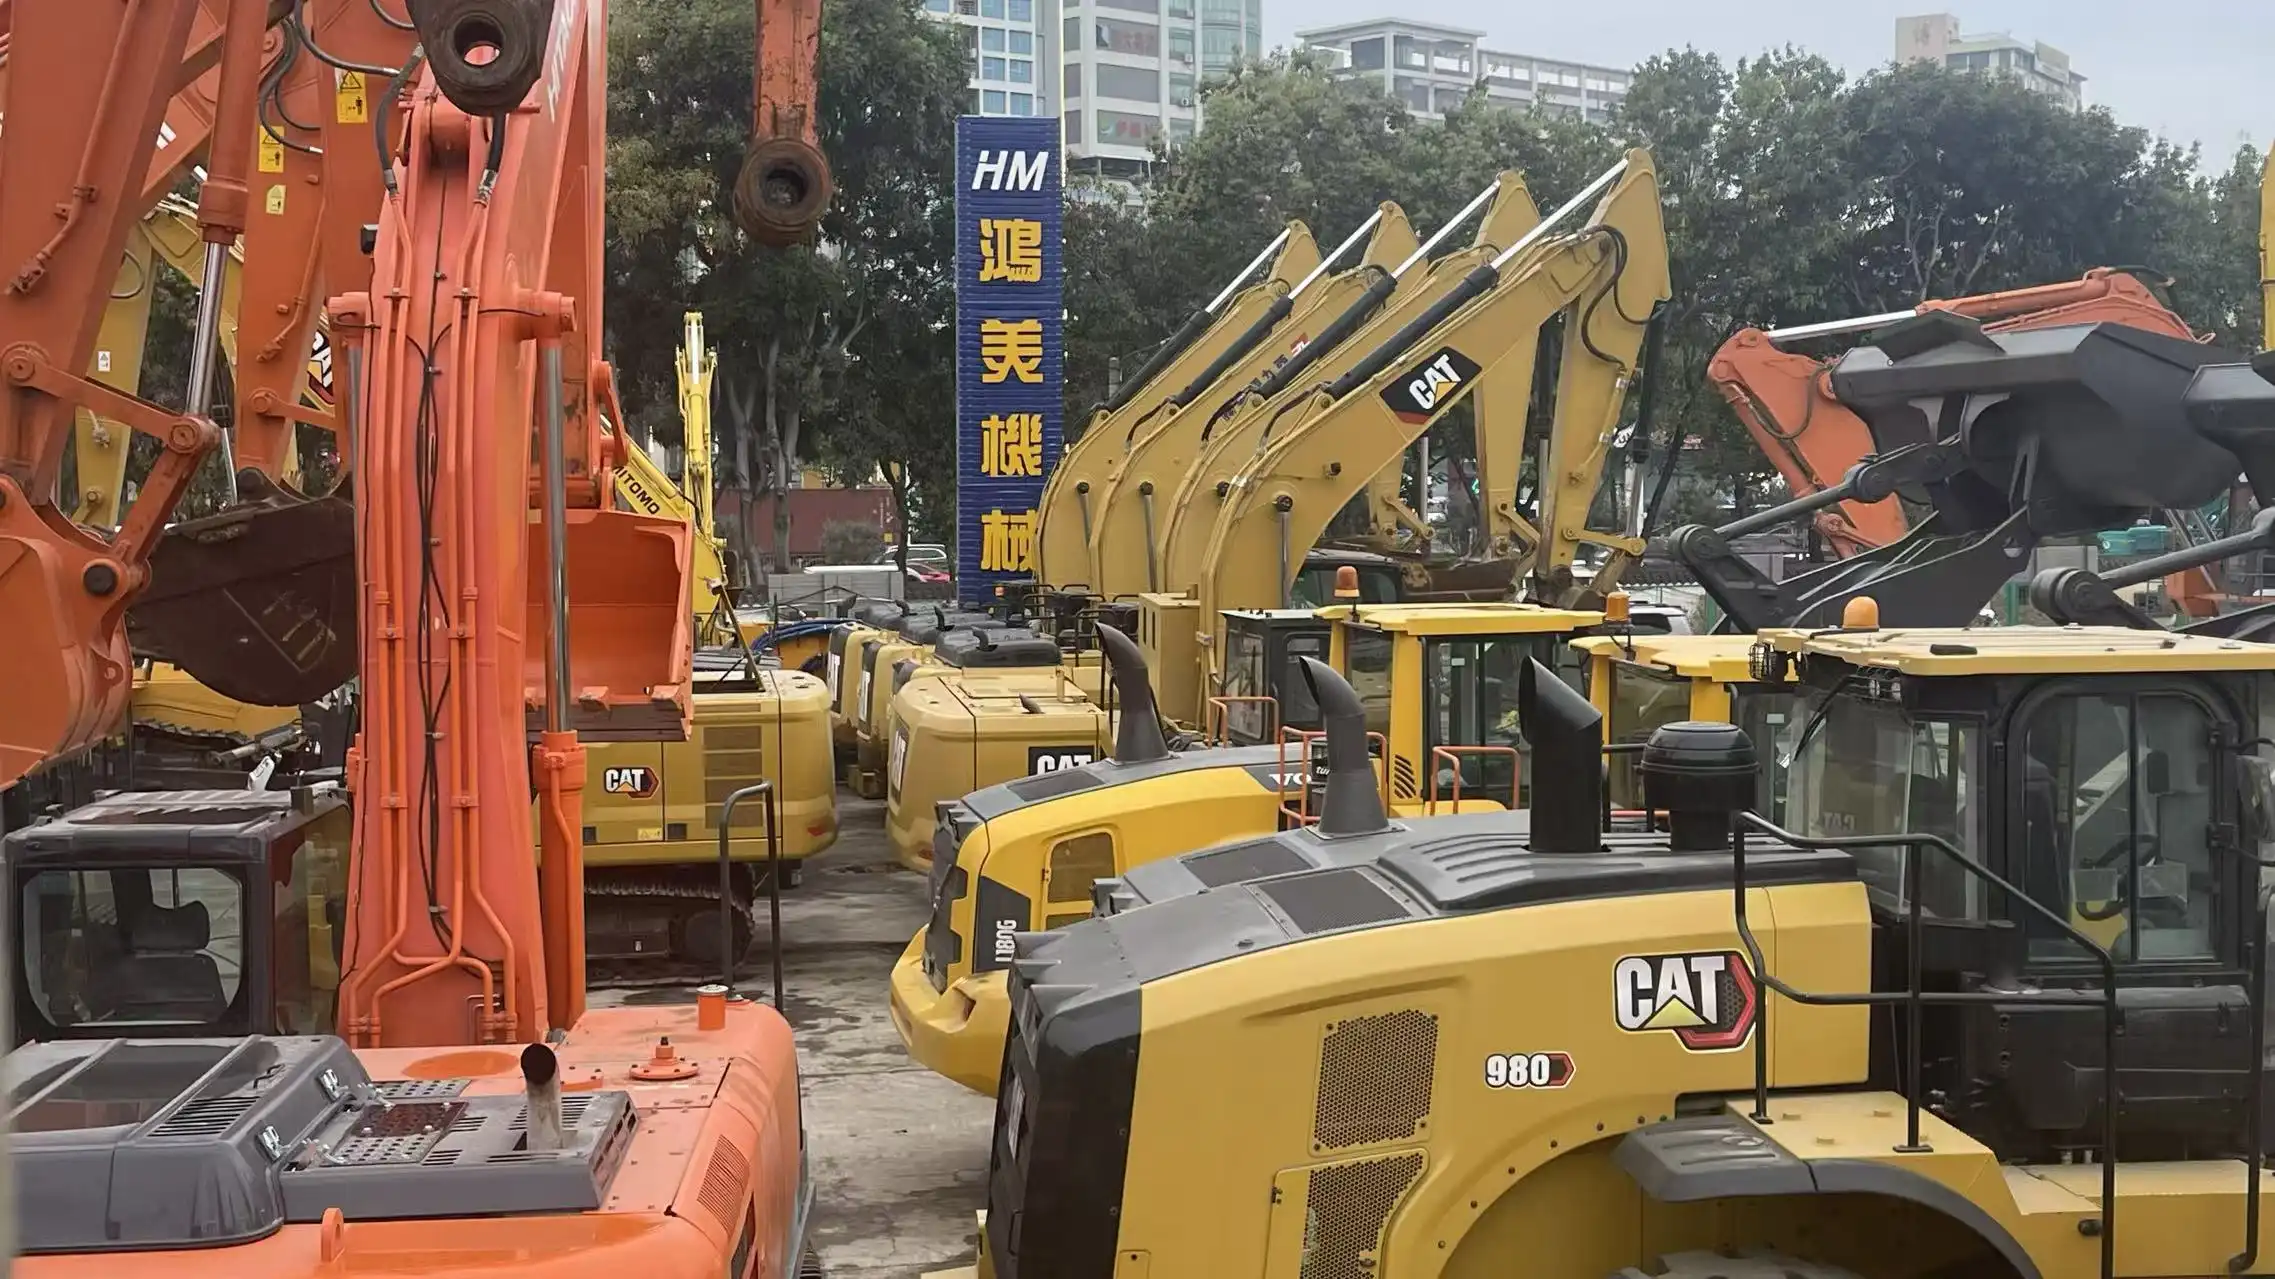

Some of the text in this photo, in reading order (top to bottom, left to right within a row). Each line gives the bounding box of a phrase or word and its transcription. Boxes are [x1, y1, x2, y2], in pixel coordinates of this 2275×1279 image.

[972, 151, 1049, 191] HM
[979, 218, 1044, 572] 鴻美機械
[1409, 354, 1461, 410] CAT
[605, 769, 645, 792] CAT
[1616, 956, 1725, 1028] CAT
[1486, 1054, 1550, 1086] 980
